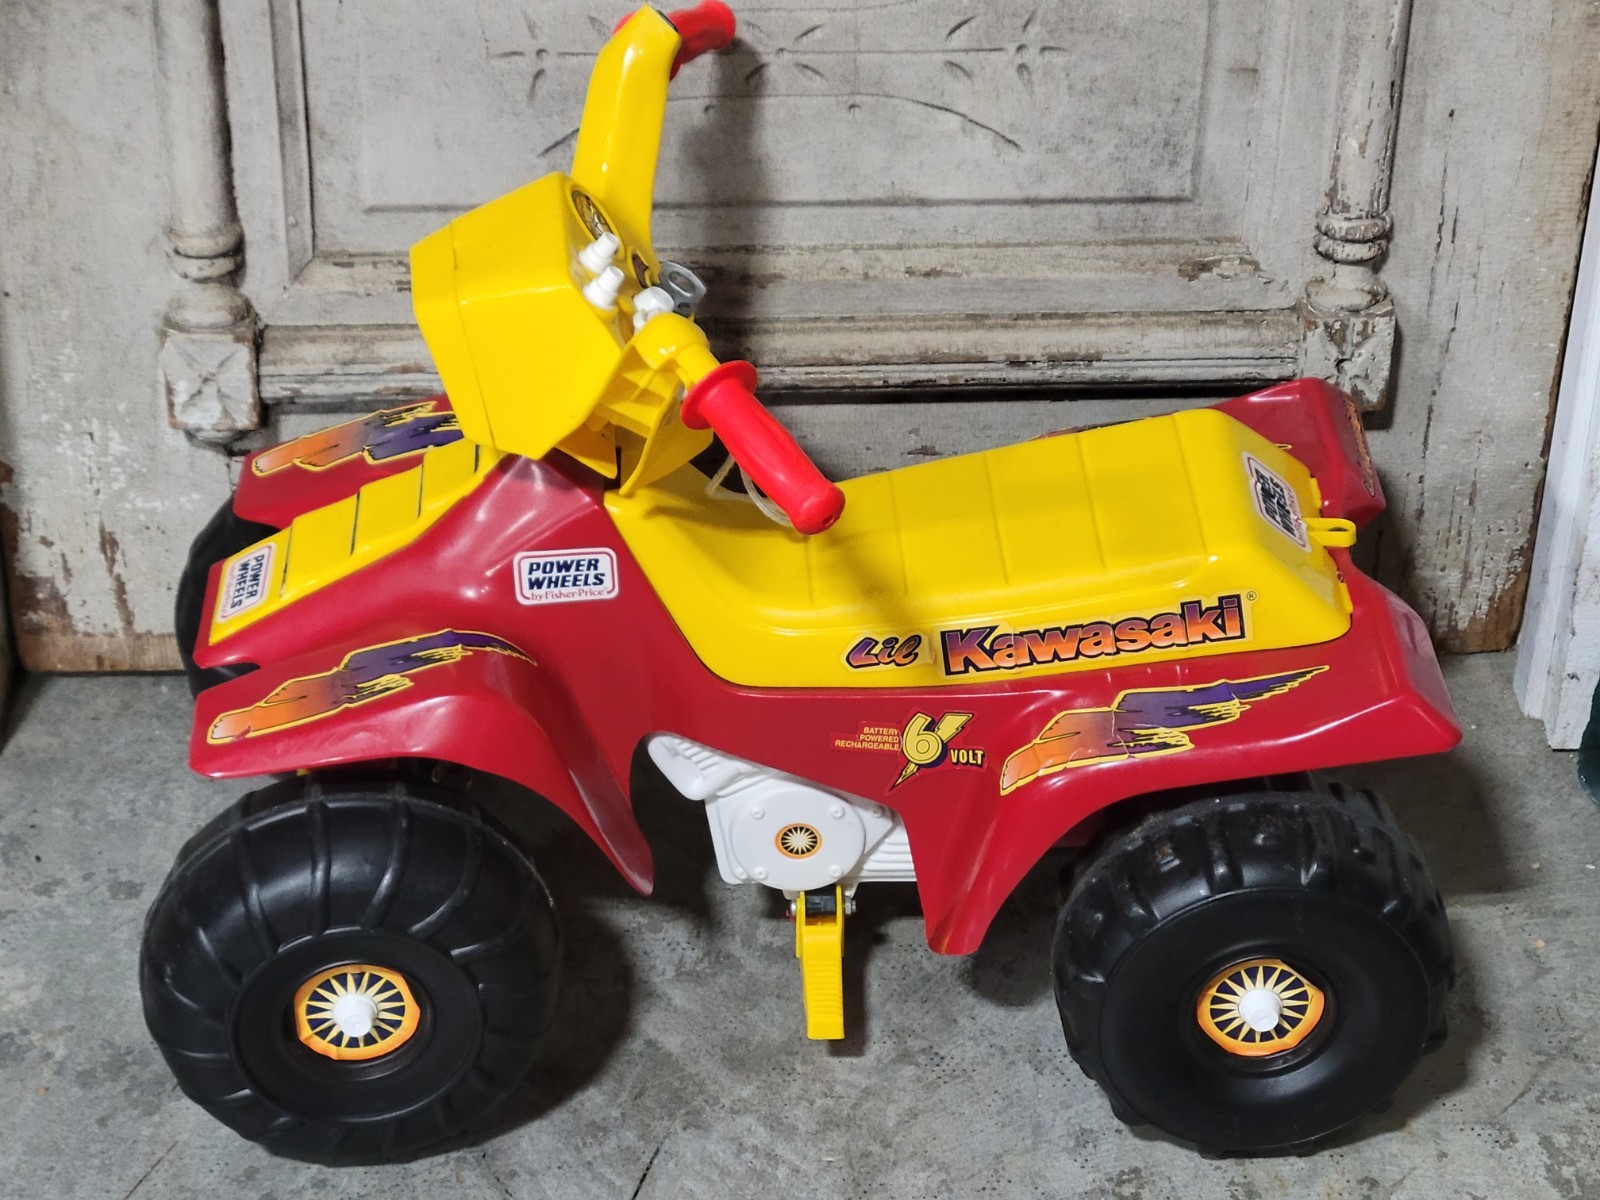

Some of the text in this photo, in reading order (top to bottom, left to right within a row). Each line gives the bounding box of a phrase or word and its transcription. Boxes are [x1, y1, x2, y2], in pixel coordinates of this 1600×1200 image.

[528, 558, 600, 575] POWER
[230, 559, 251, 609] WHEELS
[245, 554, 265, 600] POWER
[528, 572, 606, 590] WHEELS
[531, 592, 544, 602] by
[846, 593, 1246, 676] Lil Kawasaki
[859, 734, 900, 743] POWERED
[863, 726, 899, 736] BATTERY
[902, 711, 986, 768] 6 VOLT
[834, 739, 900, 751] RECHARGEABLE
